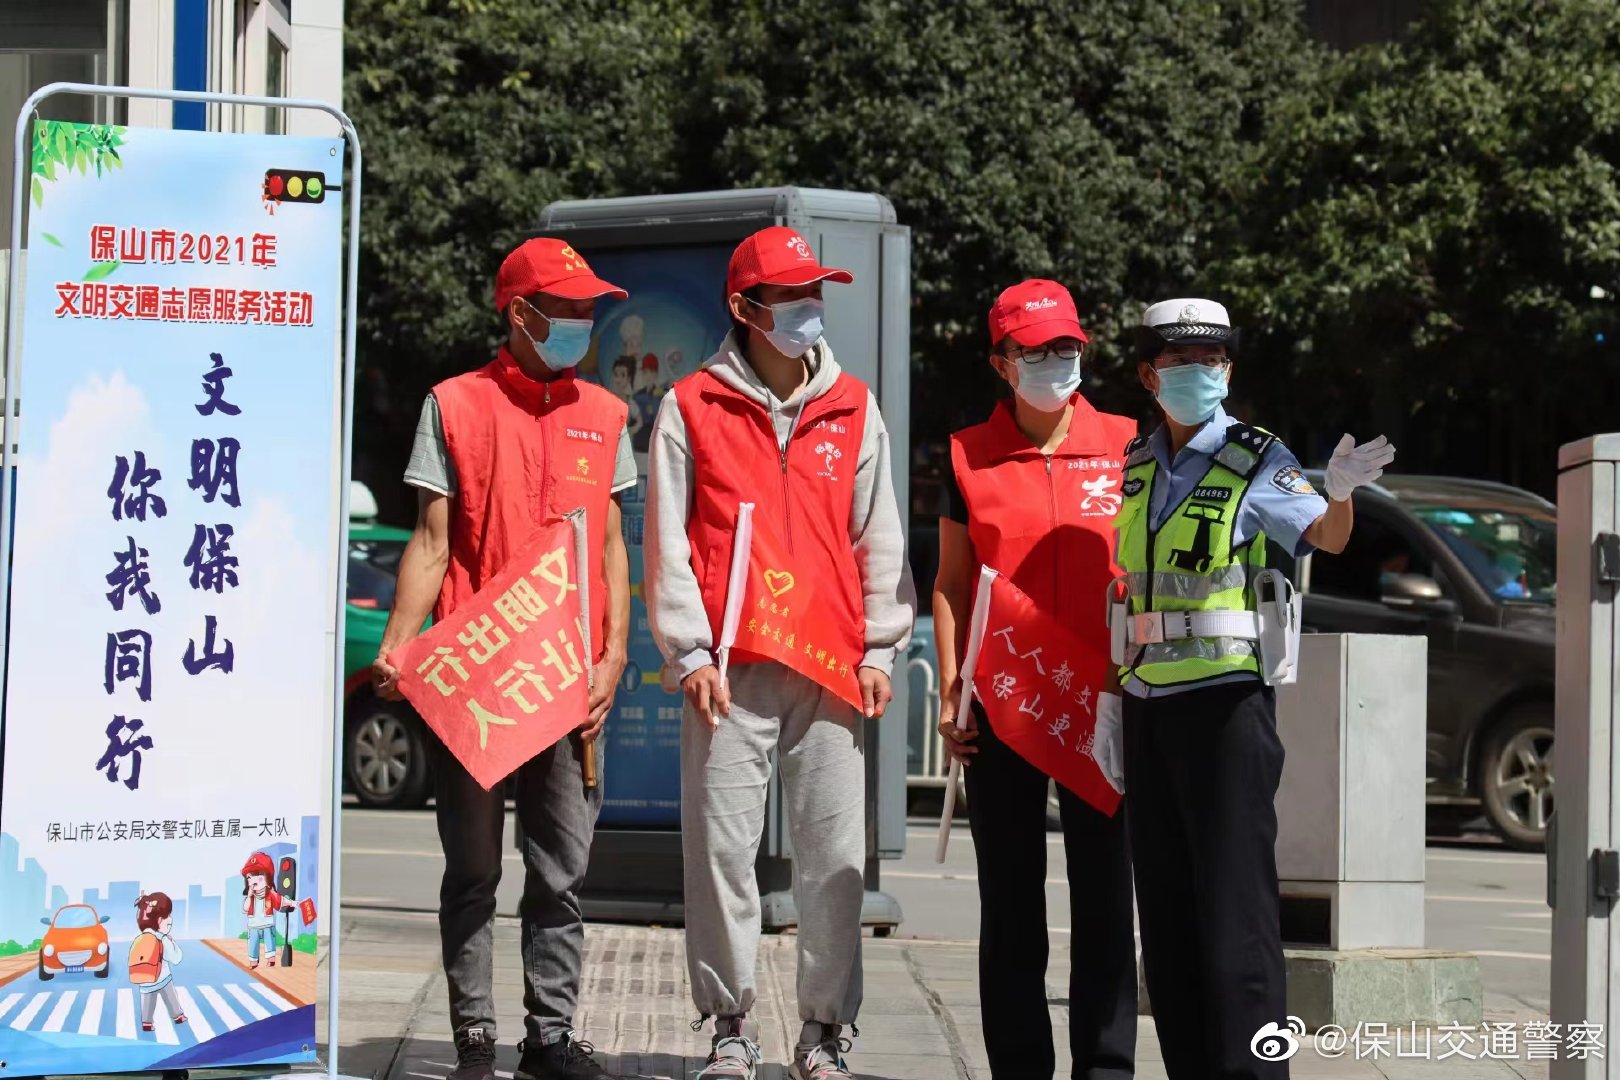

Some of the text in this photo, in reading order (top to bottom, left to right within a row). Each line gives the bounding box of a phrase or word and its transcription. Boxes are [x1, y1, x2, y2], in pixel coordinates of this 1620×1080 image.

[90, 225, 277, 266] 保山市2021年
[55, 282, 313, 325] 文明交通志愿服务活动
[182, 352, 242, 675] 文明保山
[96, 451, 167, 790] 你我同行
[745, 618, 849, 678] 安全交通 文明出行
[46, 816, 289, 843] 保山市公安局交警支队直属一大队
